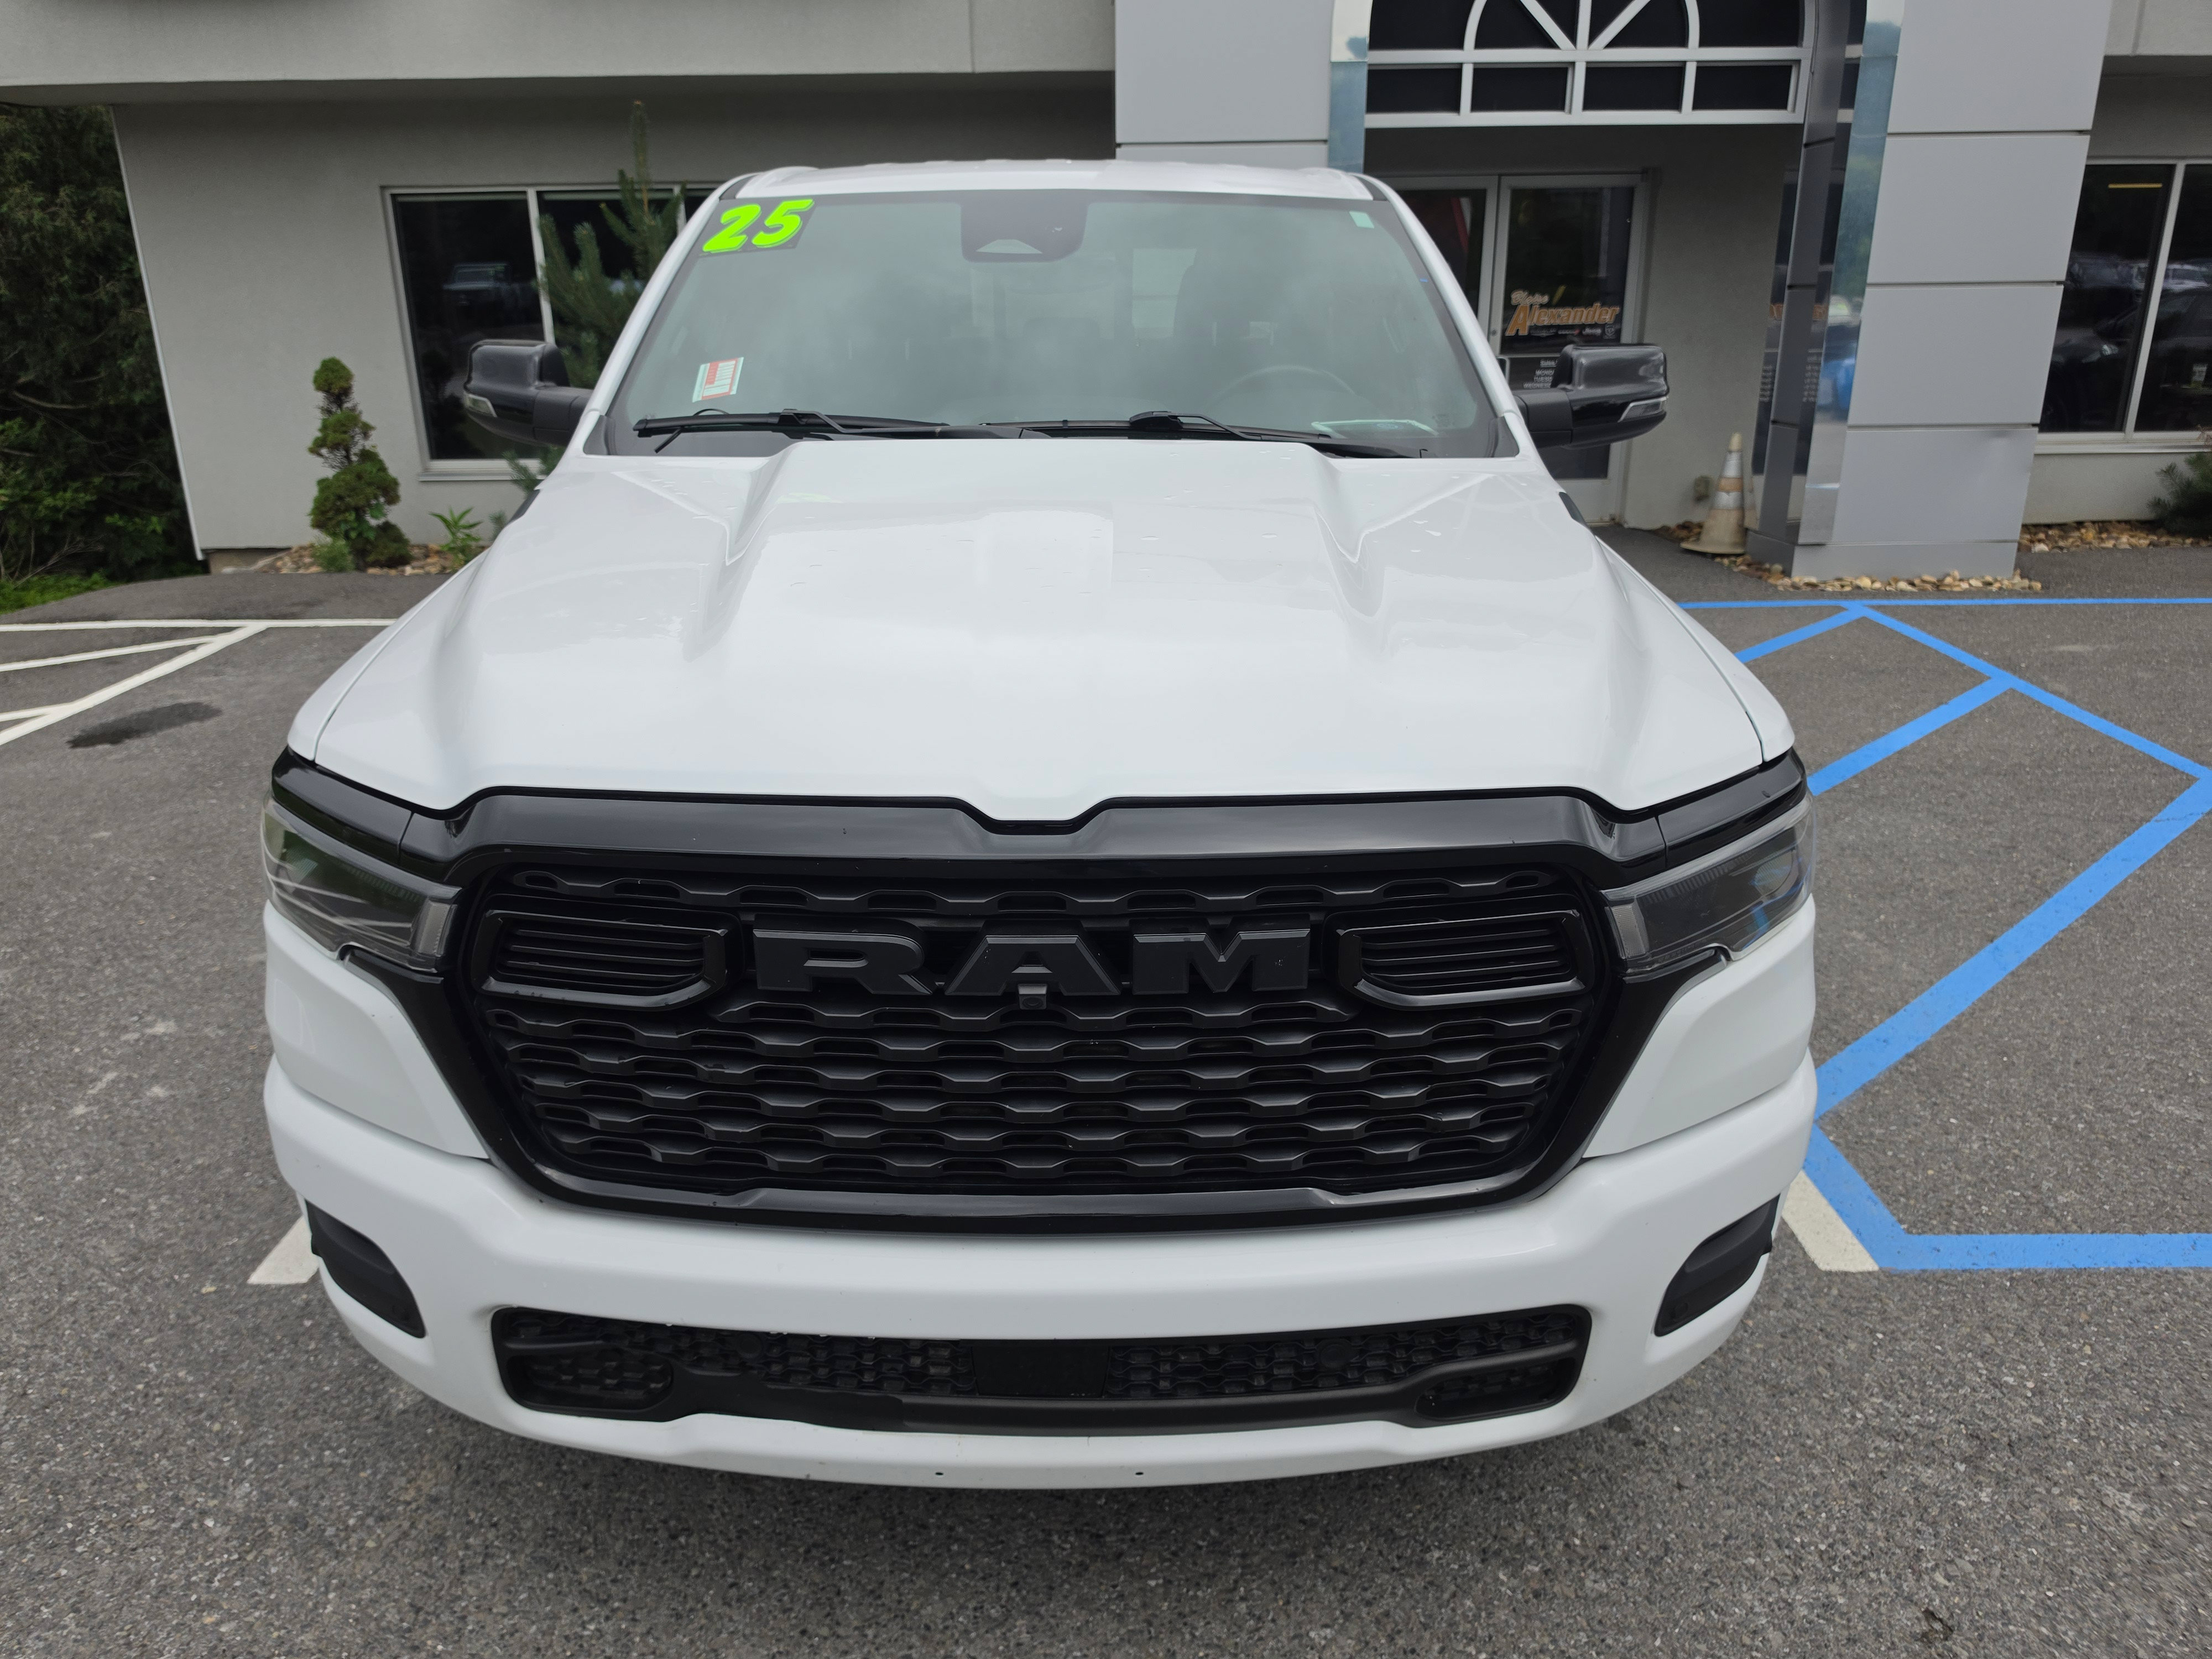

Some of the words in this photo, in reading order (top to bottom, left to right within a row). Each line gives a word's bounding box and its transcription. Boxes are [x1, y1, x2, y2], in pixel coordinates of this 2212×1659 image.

[702, 199, 814, 253] 25
[1505, 301, 1619, 336] Alexander
[753, 922, 1311, 997] RAM
